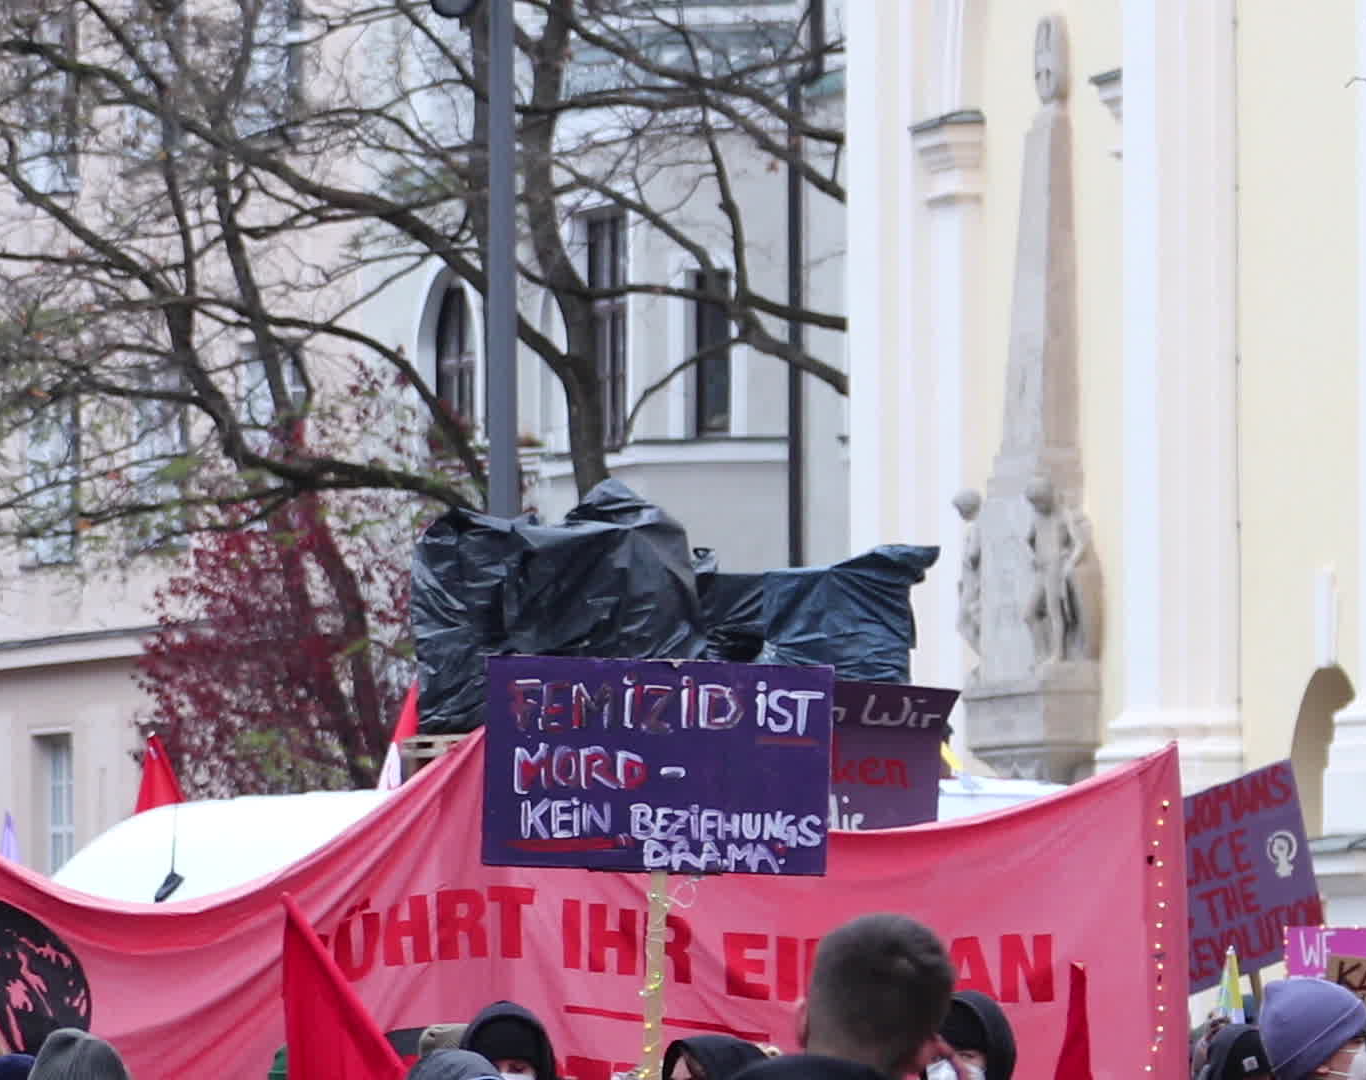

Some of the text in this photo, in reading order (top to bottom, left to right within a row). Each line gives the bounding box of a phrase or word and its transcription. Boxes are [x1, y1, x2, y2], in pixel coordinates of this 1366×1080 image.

[860, 694, 942, 728] Wir
[513, 742, 648, 795] MORD
[318, 884, 536, 982] ÜHRT
[562, 897, 692, 985] IHR
[722, 931, 818, 1002] EI
